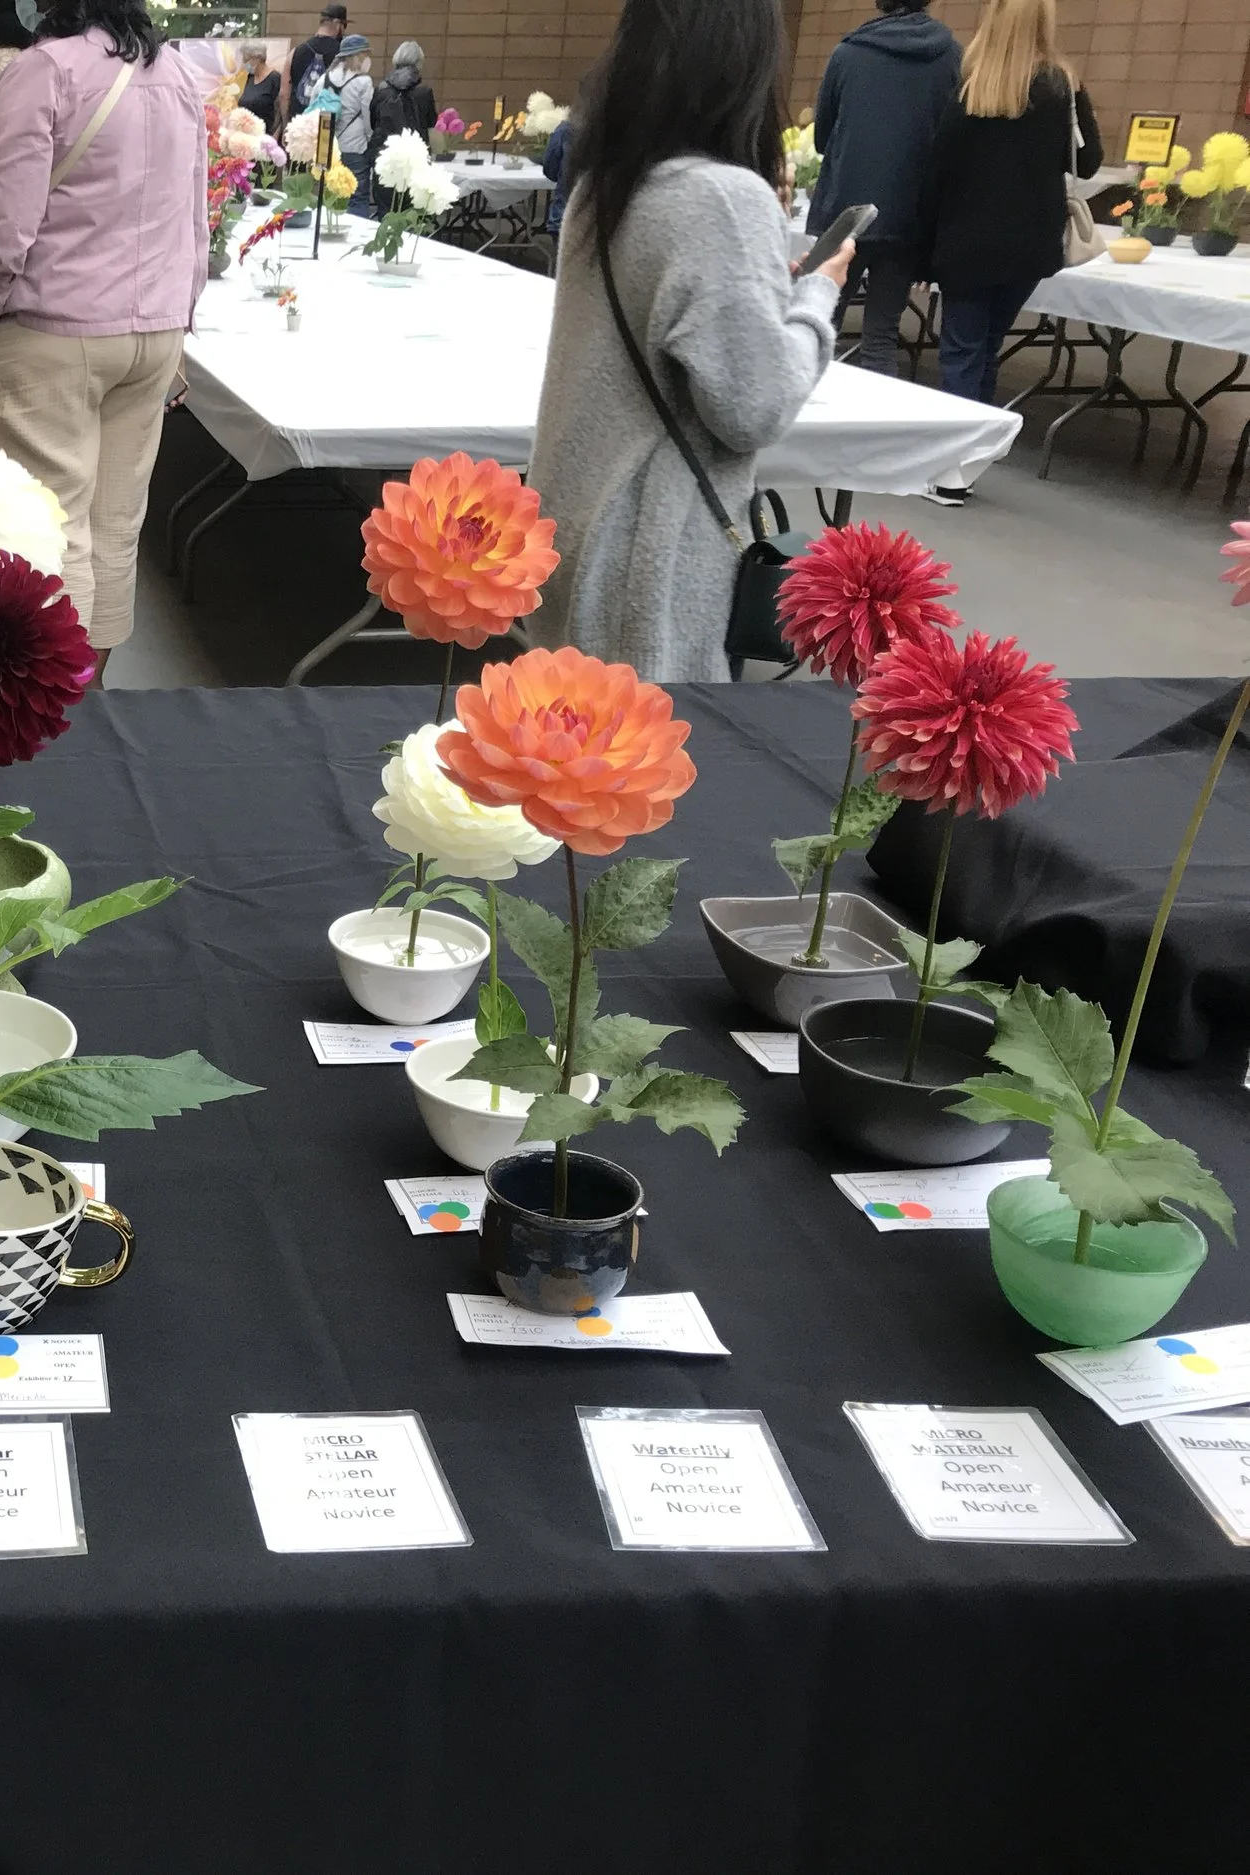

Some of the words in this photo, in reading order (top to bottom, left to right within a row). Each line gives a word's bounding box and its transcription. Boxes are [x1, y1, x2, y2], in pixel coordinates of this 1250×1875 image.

[304, 1434, 363, 1446] MICRO
[920, 1428, 983, 1440] MICRO
[910, 1443, 1014, 1456] WATERLILY
[1178, 1436, 1250, 1450] Novelty
[305, 1449, 378, 1461] STELLAR
[632, 1443, 731, 1458] Waterlily
[659, 1462, 718, 1477] Open
[945, 1461, 1004, 1476] Open
[306, 1486, 398, 1499] Amateur
[650, 1482, 743, 1495] Amateur
[940, 1480, 1035, 1494] Amateur
[323, 1506, 396, 1520] Novice
[666, 1501, 742, 1514] Novice
[962, 1499, 1040, 1514] Novice
